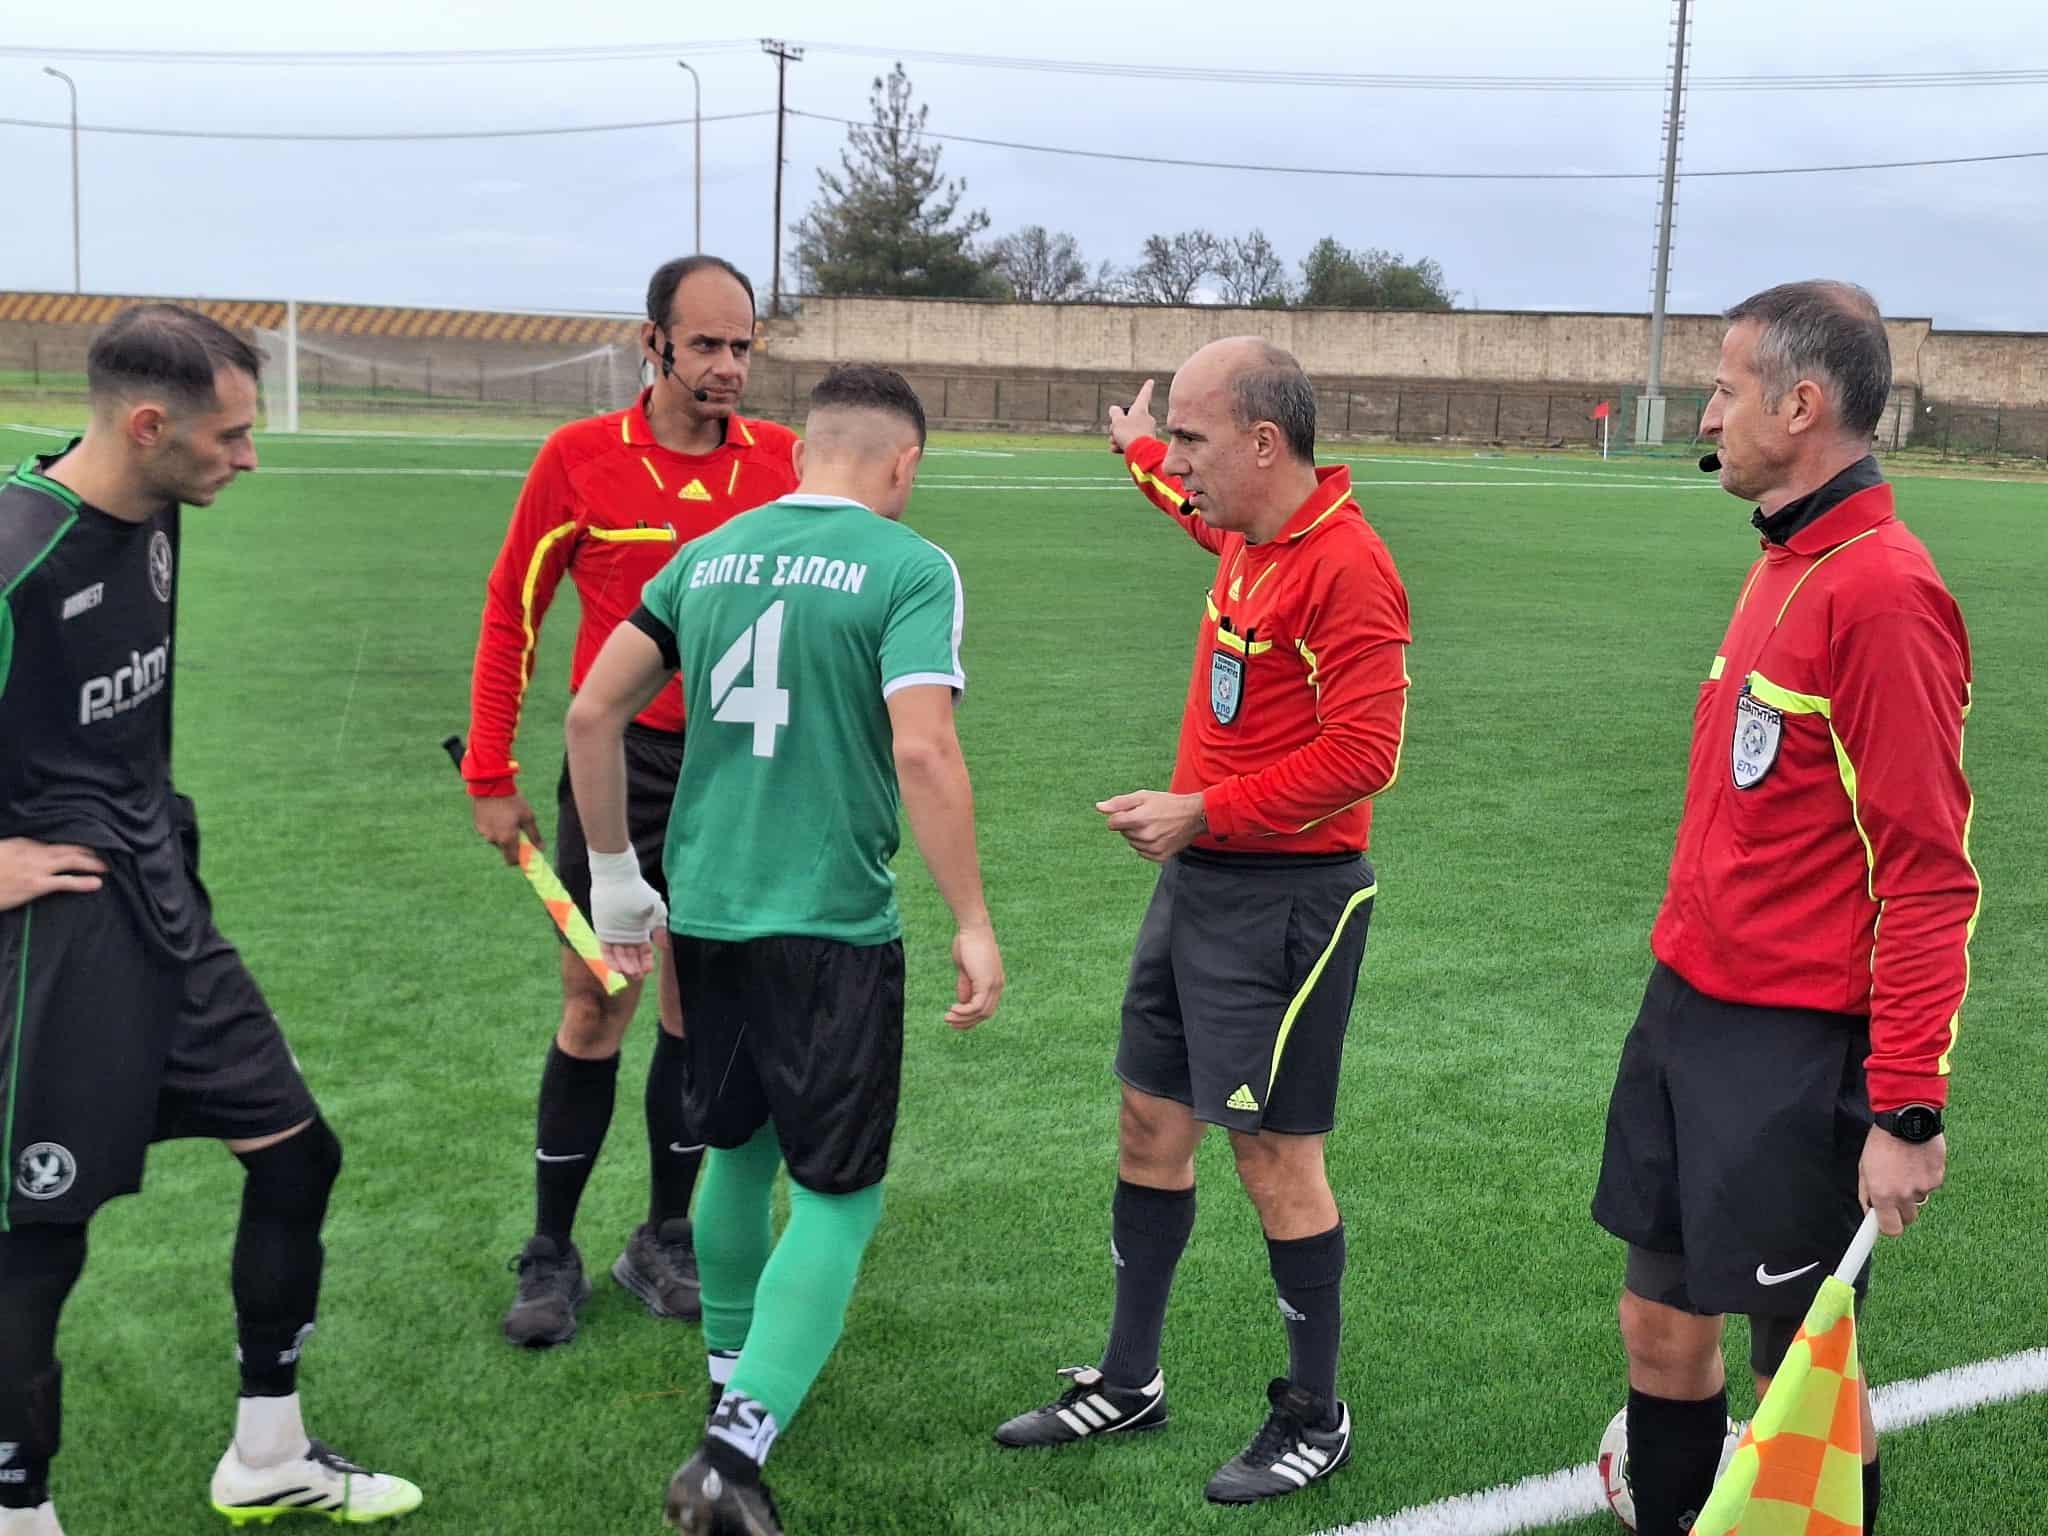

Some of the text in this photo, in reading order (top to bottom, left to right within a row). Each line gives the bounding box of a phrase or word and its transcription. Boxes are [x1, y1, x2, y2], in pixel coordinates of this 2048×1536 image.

[690, 554, 867, 594] ΕΛΠΙΣ ΣΑΠΩΝ
[710, 600, 789, 758] 4
